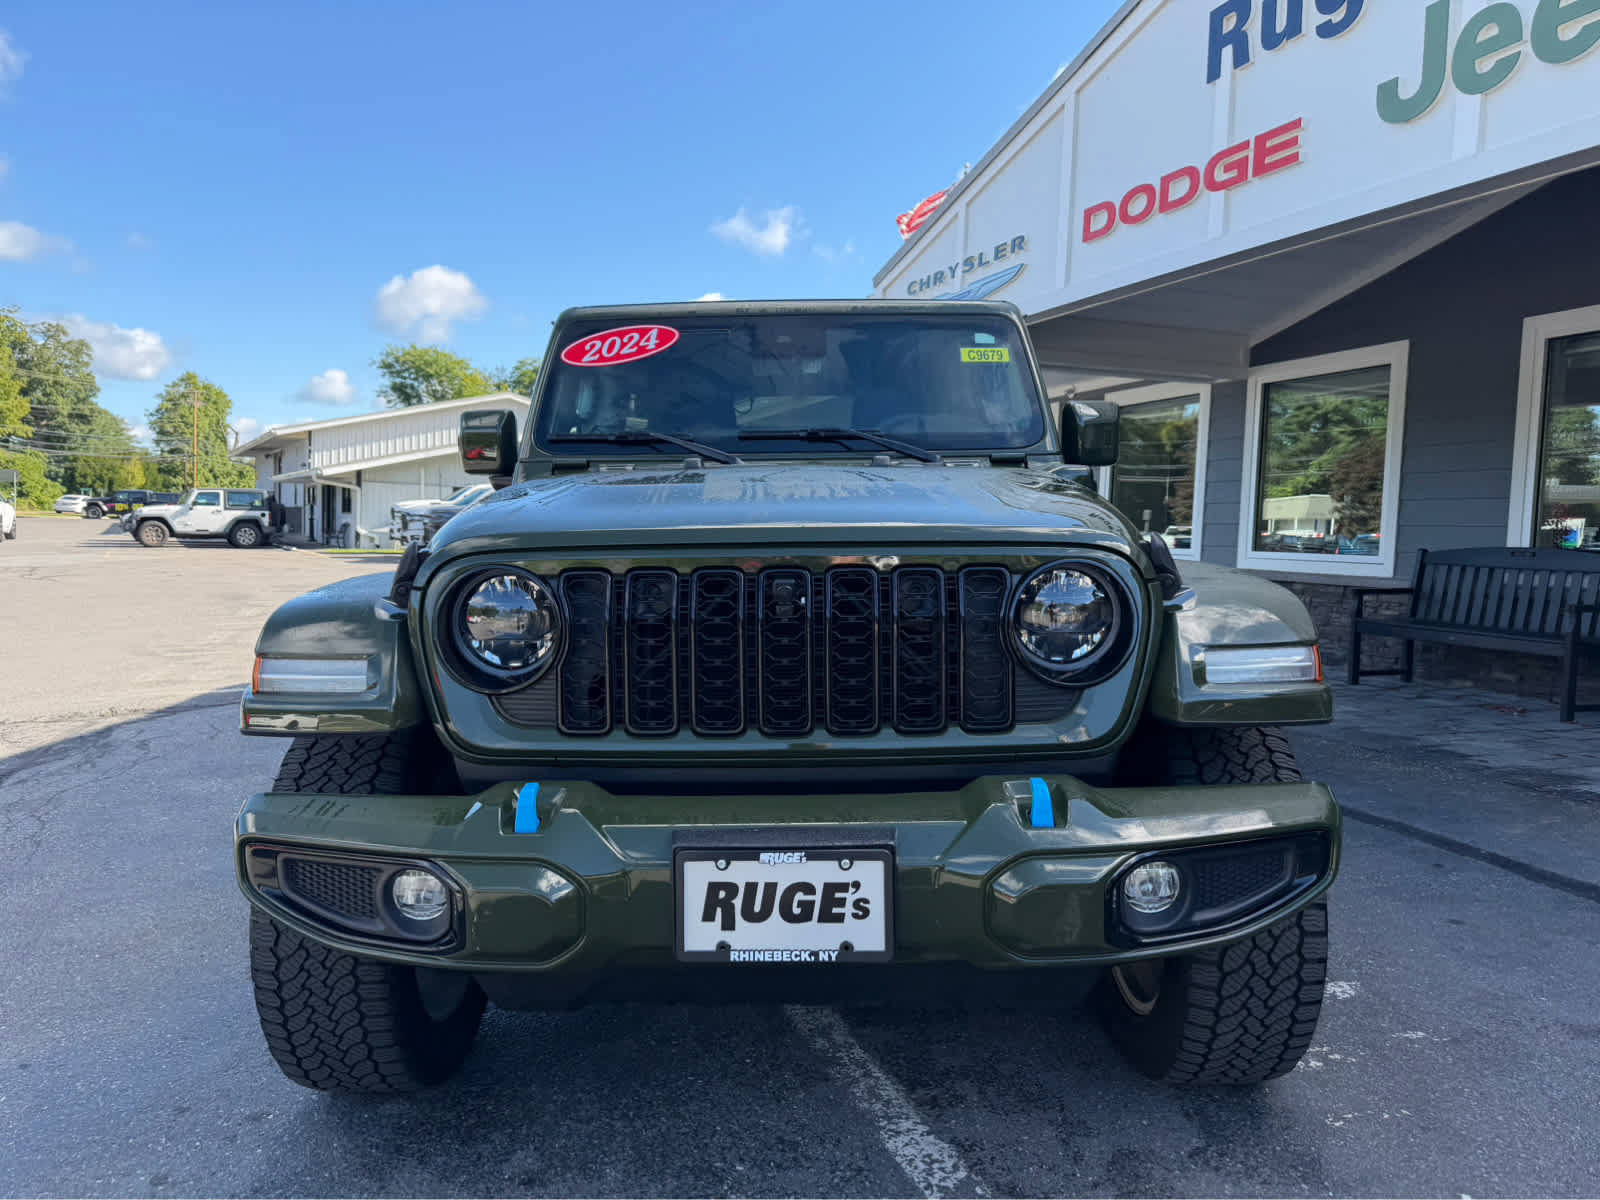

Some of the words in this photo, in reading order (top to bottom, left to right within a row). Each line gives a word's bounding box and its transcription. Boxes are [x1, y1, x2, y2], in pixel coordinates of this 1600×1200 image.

[1082, 117, 1303, 243] DODGE
[906, 234, 1025, 296] CHRYSLER
[582, 328, 661, 362] 2024
[967, 350, 1003, 361] C9679
[818, 950, 839, 962] NY
